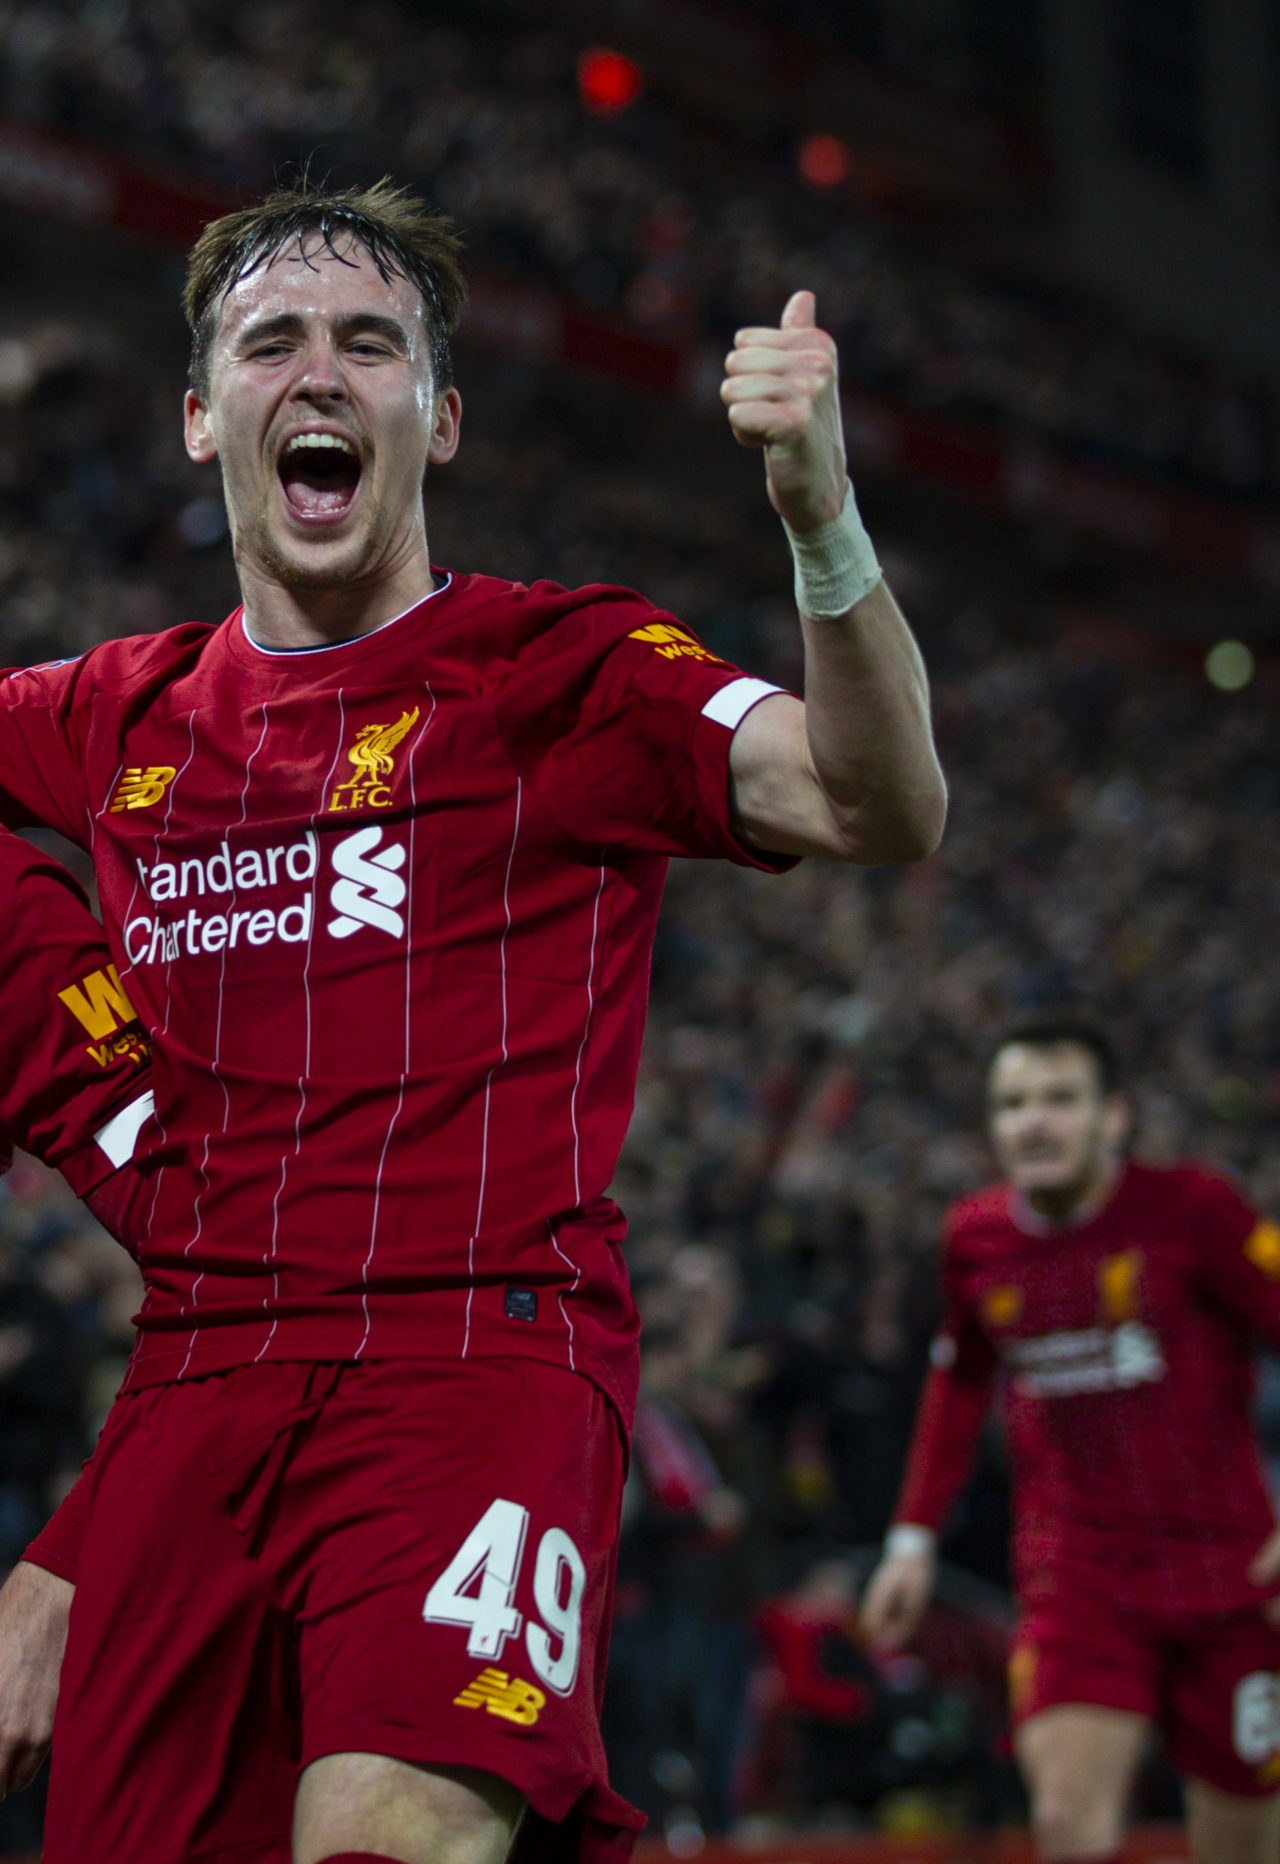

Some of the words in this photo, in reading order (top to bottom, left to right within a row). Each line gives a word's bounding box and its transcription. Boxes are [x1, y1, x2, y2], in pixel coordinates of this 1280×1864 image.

[654, 643, 707, 660] Wes
[136, 830, 318, 902] tandard
[125, 892, 313, 965] Chartered
[422, 1497, 587, 1698] 49
